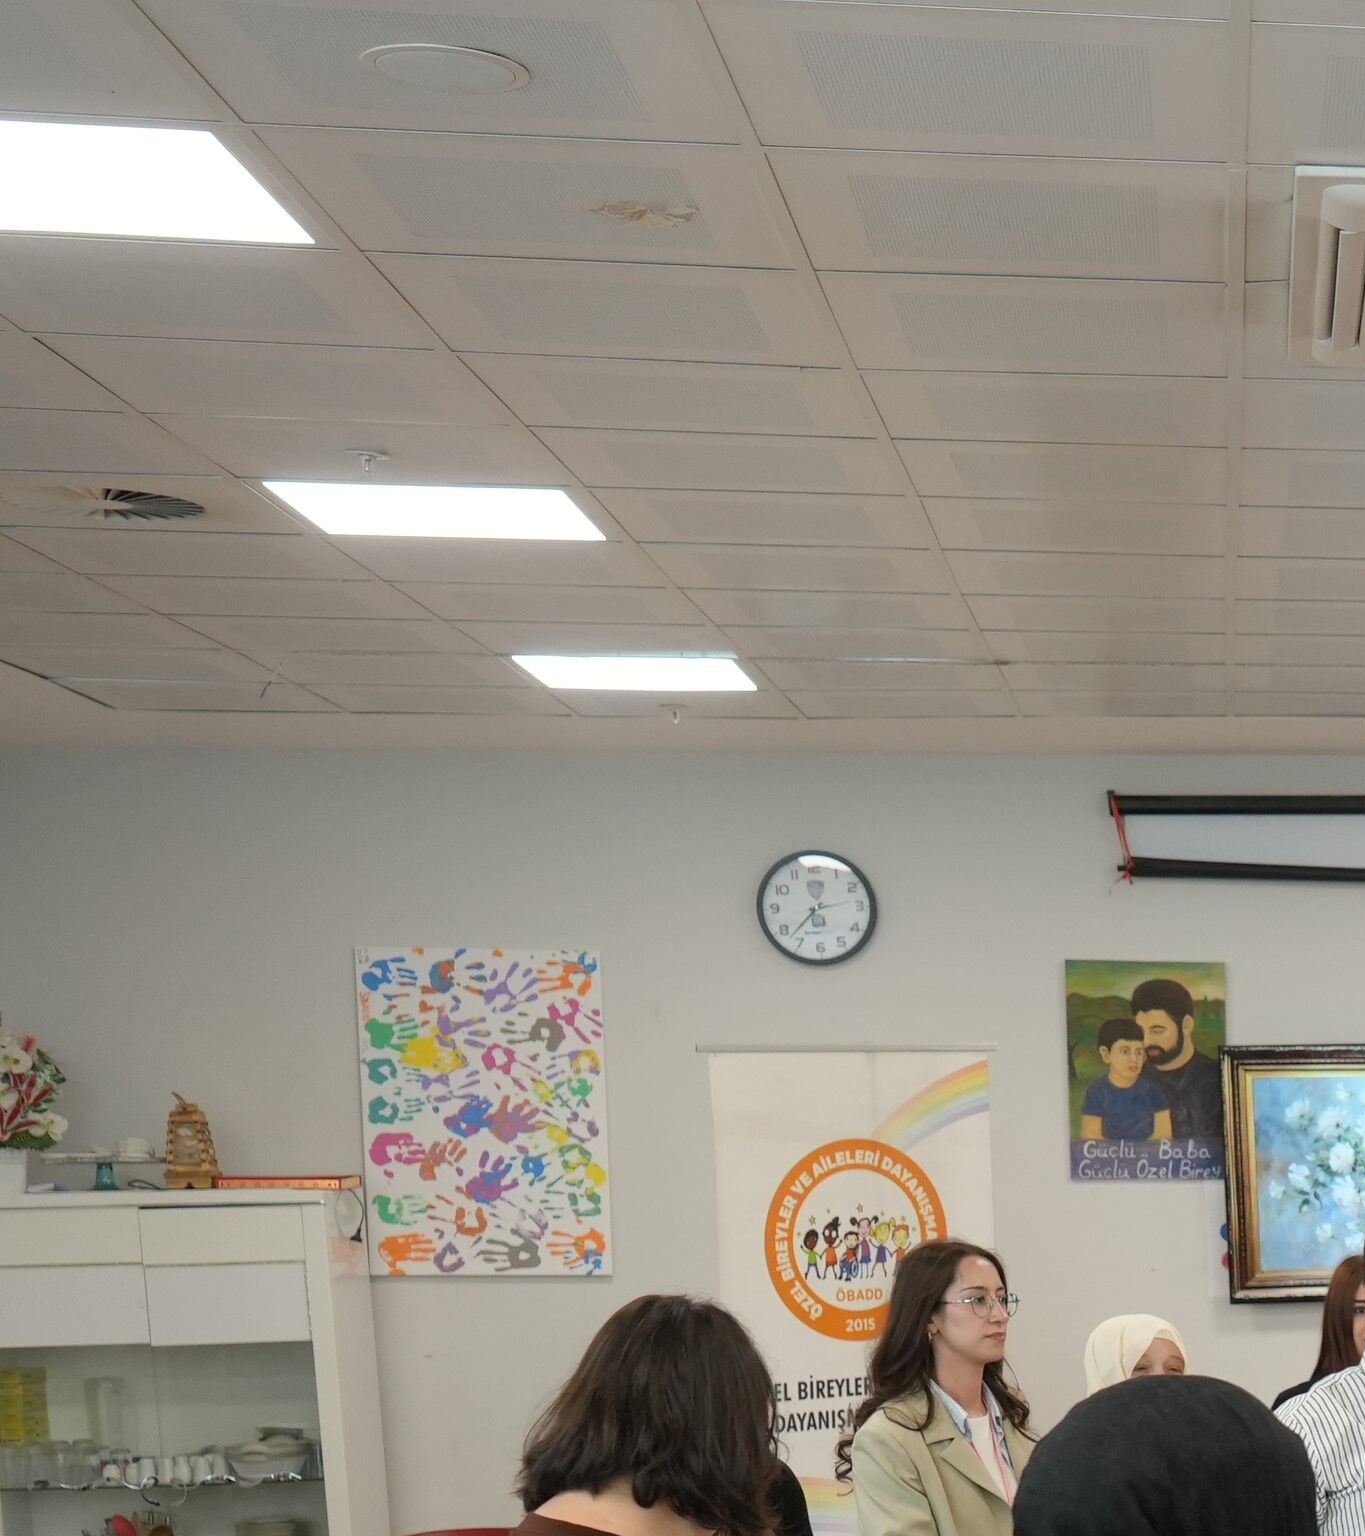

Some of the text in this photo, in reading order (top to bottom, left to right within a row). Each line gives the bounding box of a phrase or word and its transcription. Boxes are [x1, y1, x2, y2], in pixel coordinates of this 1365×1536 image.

[790, 869, 799, 881] 11
[775, 883, 790, 896] 10
[846, 881, 857, 893] 2
[769, 903, 780, 914] 9
[854, 900, 864, 912] 3
[778, 924, 789, 936] 8
[849, 922, 860, 933] 4
[815, 942, 826, 953] 6
[836, 936, 847, 948] 5
[1158, 1138, 1211, 1159] Baba
[775, 1149, 938, 1321] ÖZEL BİREYLER VE AİLELERİ DAYANIŞMA
[836, 1287, 883, 1302] ÖBADD
[846, 1318, 875, 1332] 2015
